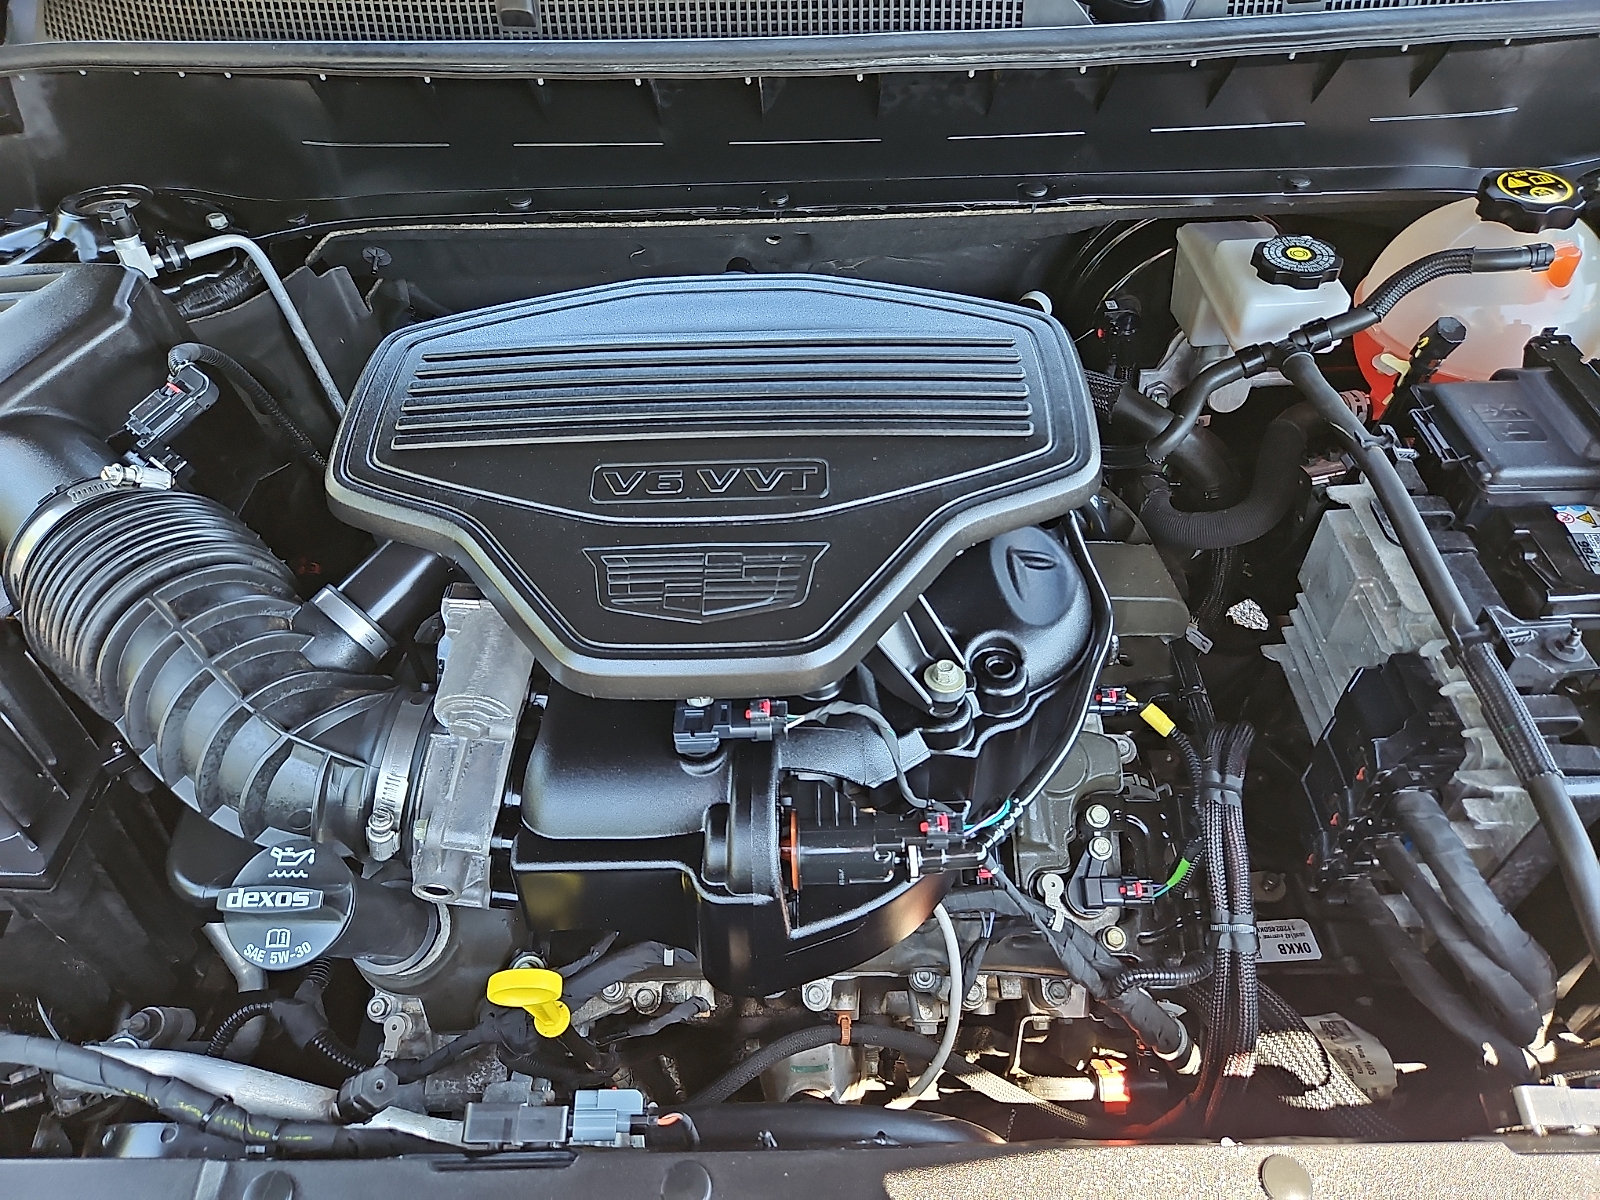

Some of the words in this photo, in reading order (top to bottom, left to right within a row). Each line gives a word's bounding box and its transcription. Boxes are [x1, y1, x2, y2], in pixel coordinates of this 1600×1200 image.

[602, 470, 684, 496] V6
[697, 466, 819, 494] VVT
[226, 887, 311, 908] dexos
[243, 943, 267, 963] SAE
[269, 941, 313, 965] 5W-30
